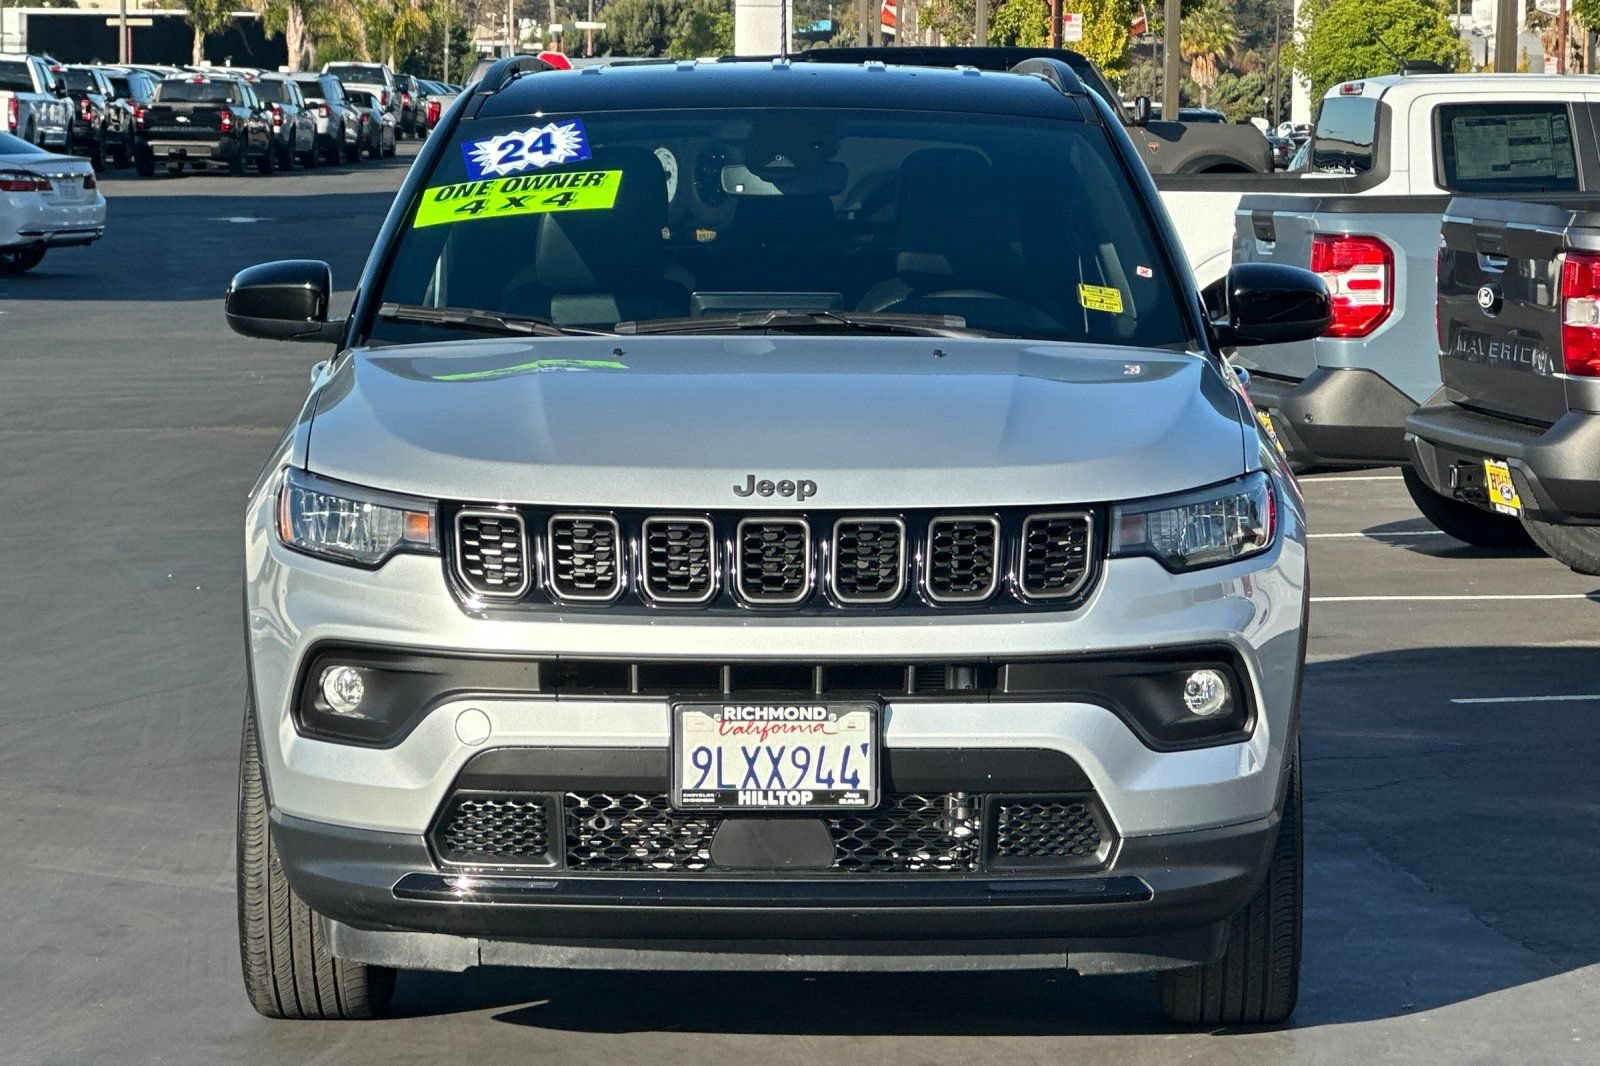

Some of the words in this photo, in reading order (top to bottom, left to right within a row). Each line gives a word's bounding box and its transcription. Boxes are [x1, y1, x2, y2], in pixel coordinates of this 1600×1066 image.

[497, 132, 556, 165] 24
[434, 180, 494, 202] ONE
[500, 172, 608, 193] OWNER
[453, 198, 491, 216] 4
[540, 190, 580, 209] 4
[732, 474, 818, 502] Jeep
[723, 706, 827, 721] RICHMOND
[719, 720, 838, 742] California
[691, 745, 861, 789] 9LXX944
[737, 790, 814, 806] HILLTOP
